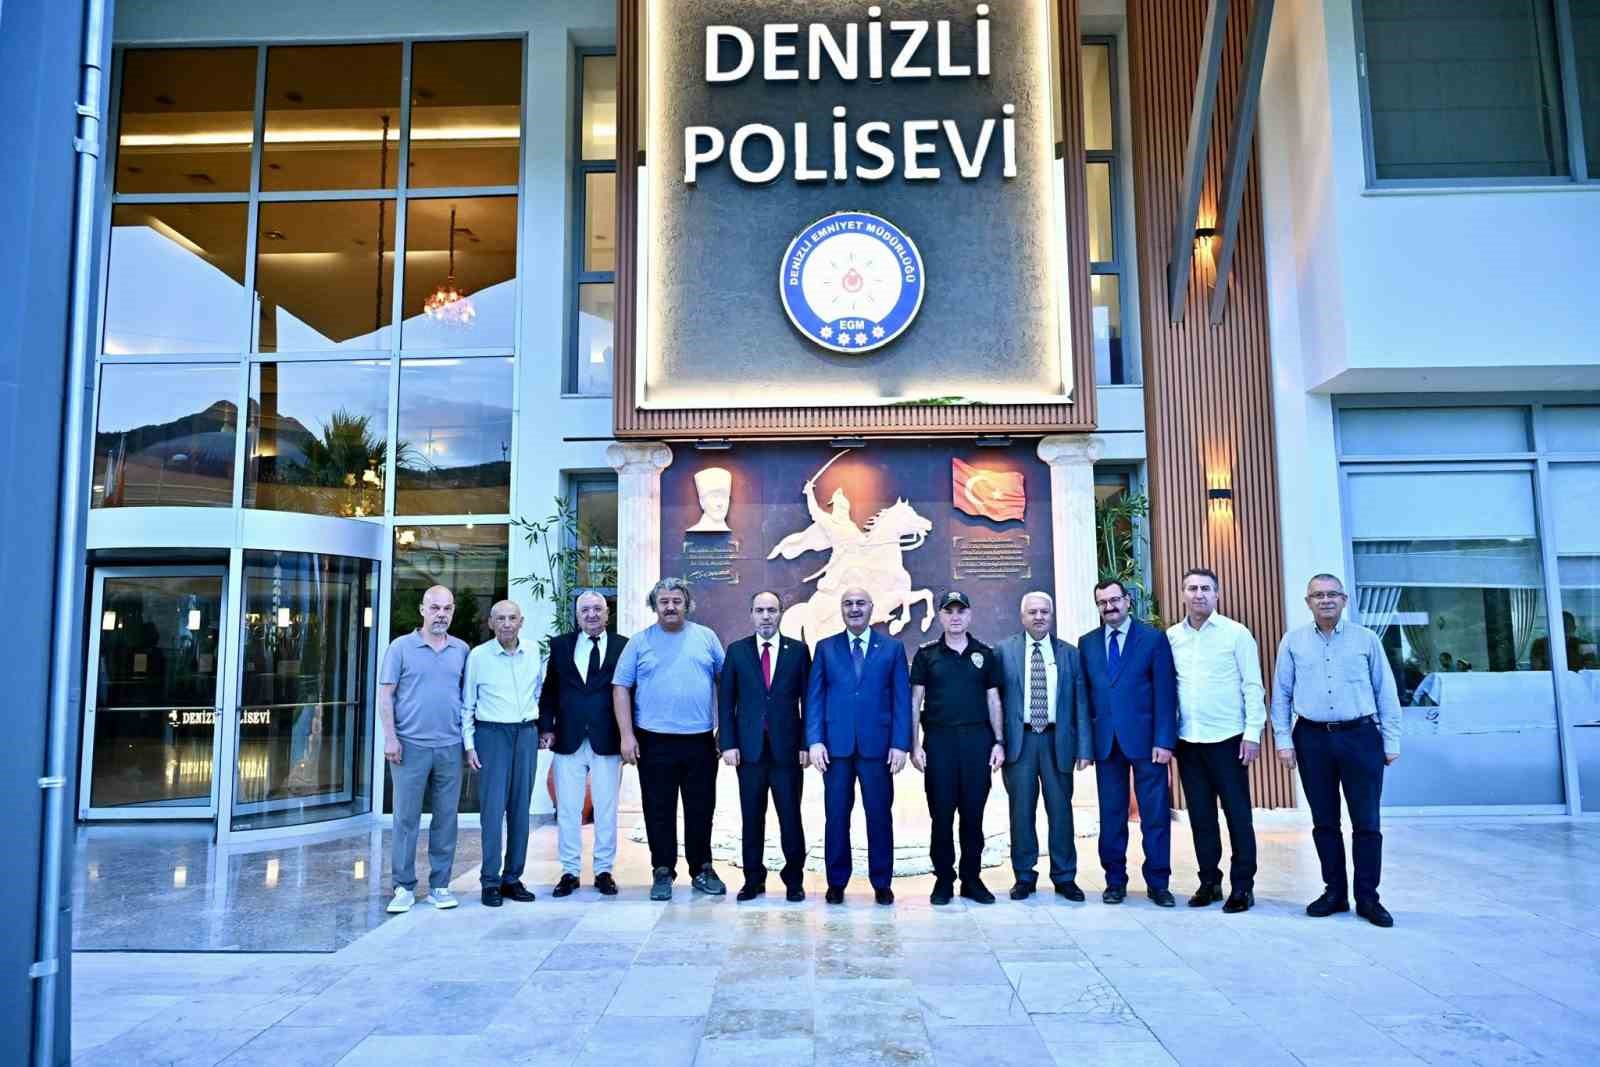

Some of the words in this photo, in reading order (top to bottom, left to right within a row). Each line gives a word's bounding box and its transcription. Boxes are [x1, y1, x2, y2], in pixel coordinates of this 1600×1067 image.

[706, 4, 991, 82] DENİZLİ
[684, 103, 1017, 183] POLİSEVİ
[811, 220, 863, 242] EMNİYET
[839, 320, 865, 330] EGM
